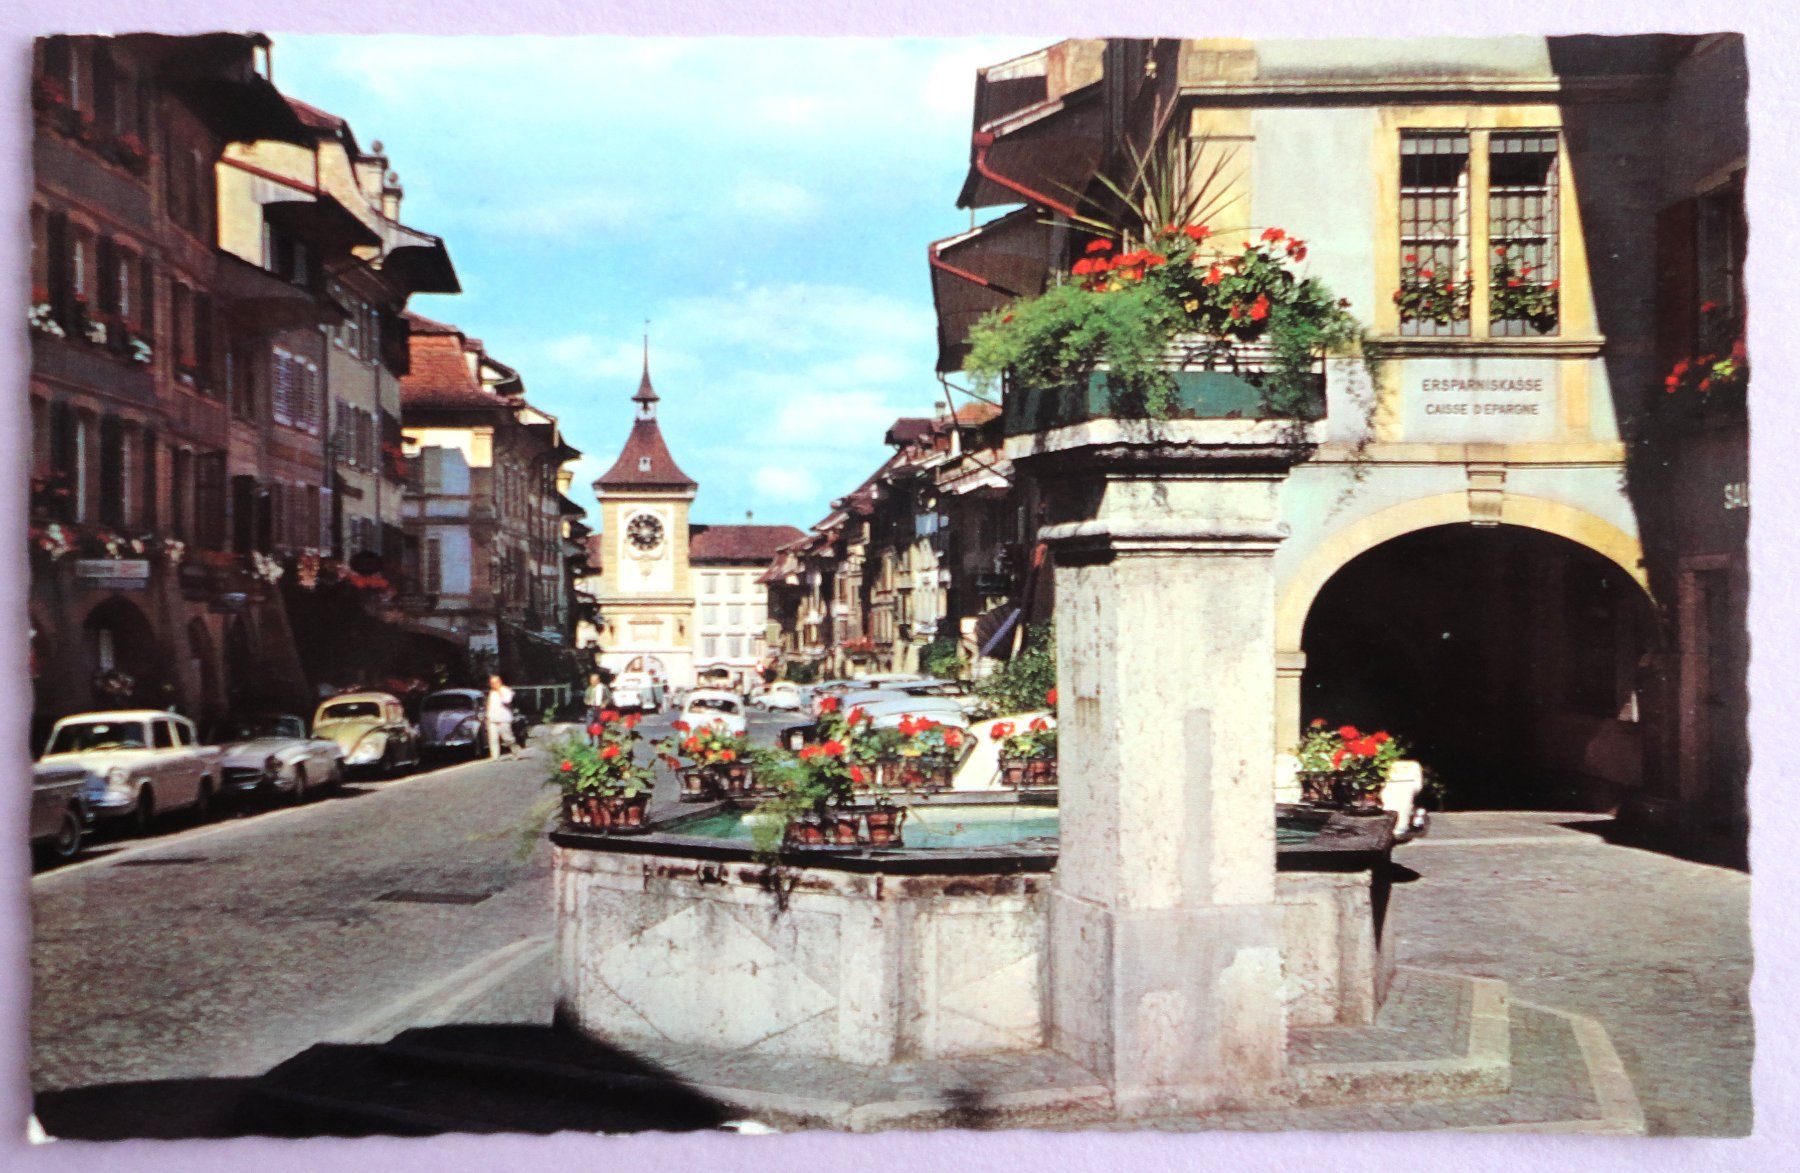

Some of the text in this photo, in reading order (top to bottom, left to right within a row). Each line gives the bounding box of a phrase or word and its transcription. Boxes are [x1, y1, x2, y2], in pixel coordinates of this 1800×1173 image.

[1422, 379, 1543, 391] ERSPARNISKASSE
[1425, 403, 1540, 415] CAISSE DEPARGNE
